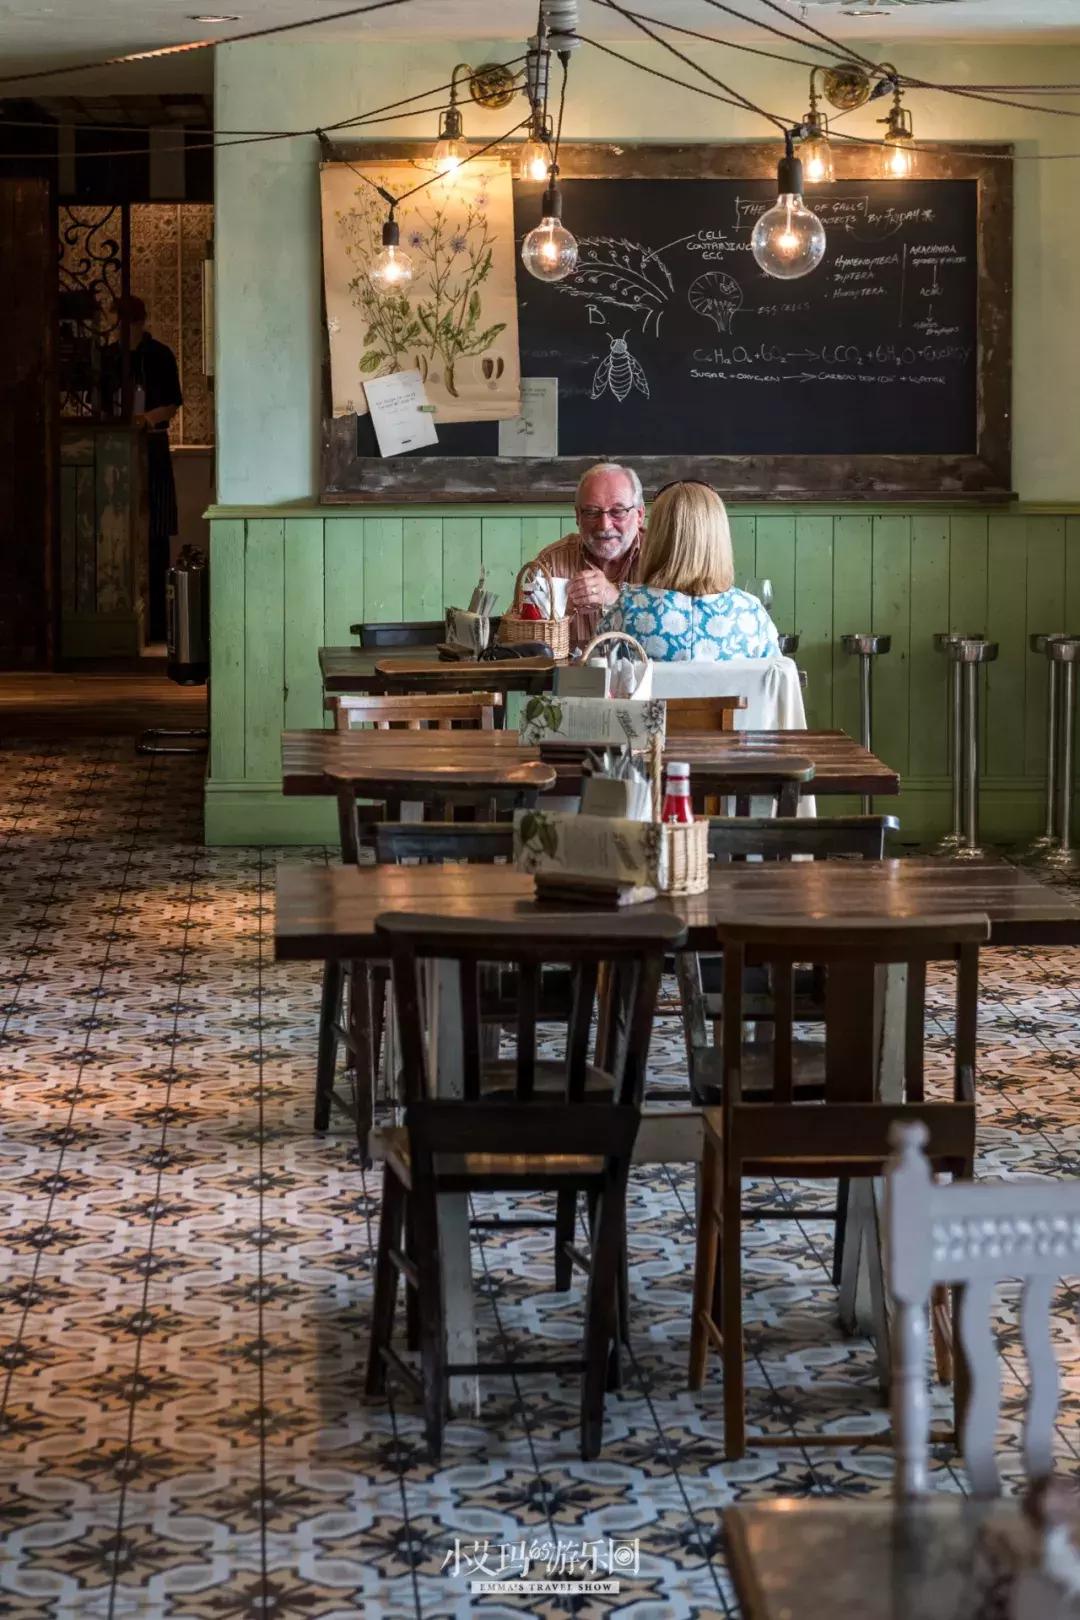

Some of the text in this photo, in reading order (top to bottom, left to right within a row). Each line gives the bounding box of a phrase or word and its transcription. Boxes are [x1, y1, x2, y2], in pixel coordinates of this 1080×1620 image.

[741, 203, 766, 216] THE
[814, 202, 830, 212] OF
[832, 201, 864, 214] GALLS
[868, 213, 882, 225] BY
[697, 230, 728, 241] CELL
[689, 368, 728, 381] SUGAR
